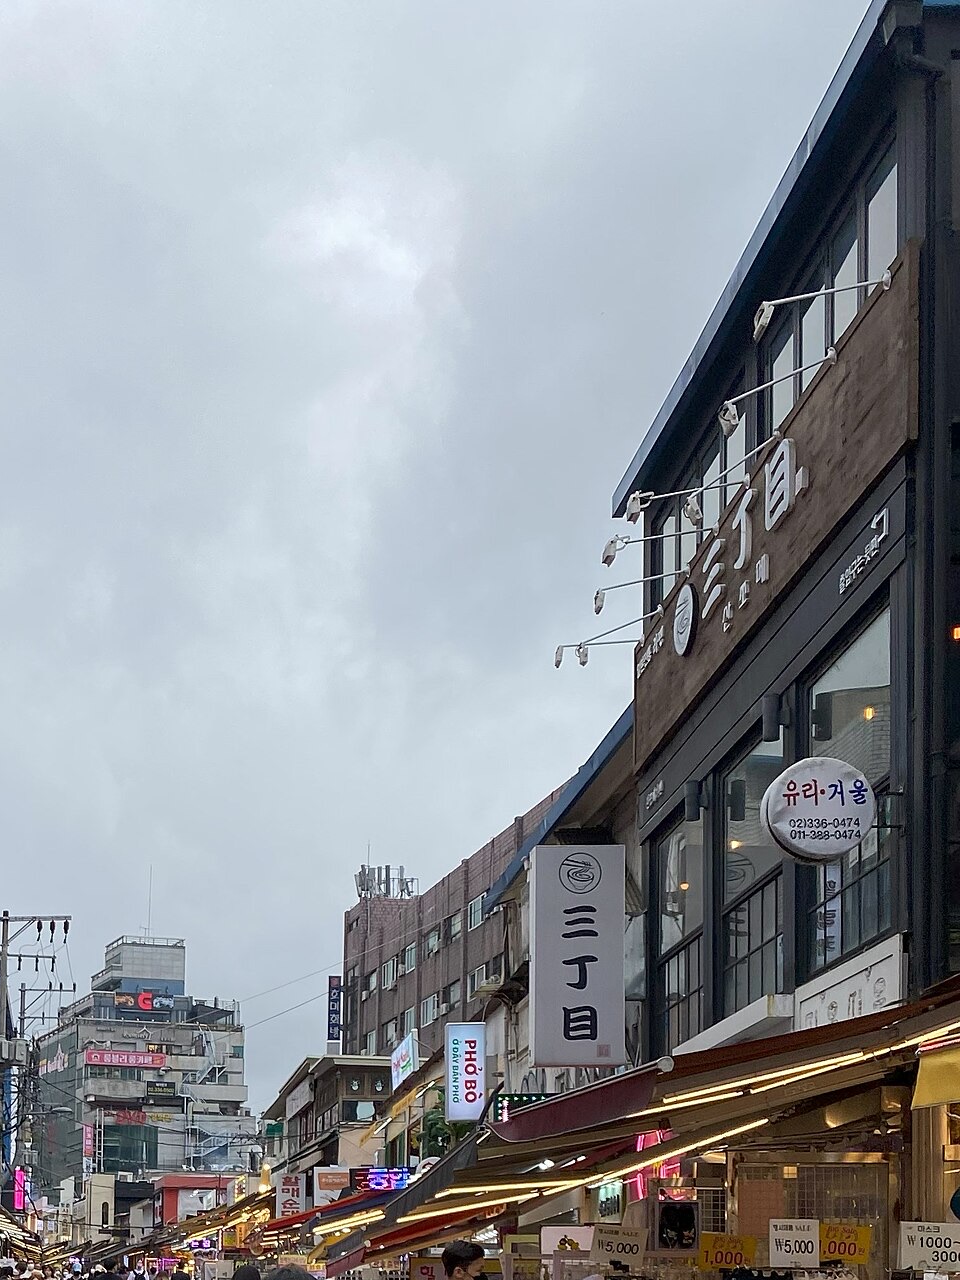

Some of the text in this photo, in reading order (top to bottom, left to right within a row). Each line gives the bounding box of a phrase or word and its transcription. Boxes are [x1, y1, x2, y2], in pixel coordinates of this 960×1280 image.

[789, 818, 860, 829] 02)336-0474
[790, 830, 862, 841] 011-388-0474
[561, 905, 599, 1041] 三丁目
[464, 1080, 482, 1103] BÒ
[917, 1225, 940, 1233] 마스크
[703, 1251, 744, 1266] 1,000
[932, 1251, 960, 1263] 300
